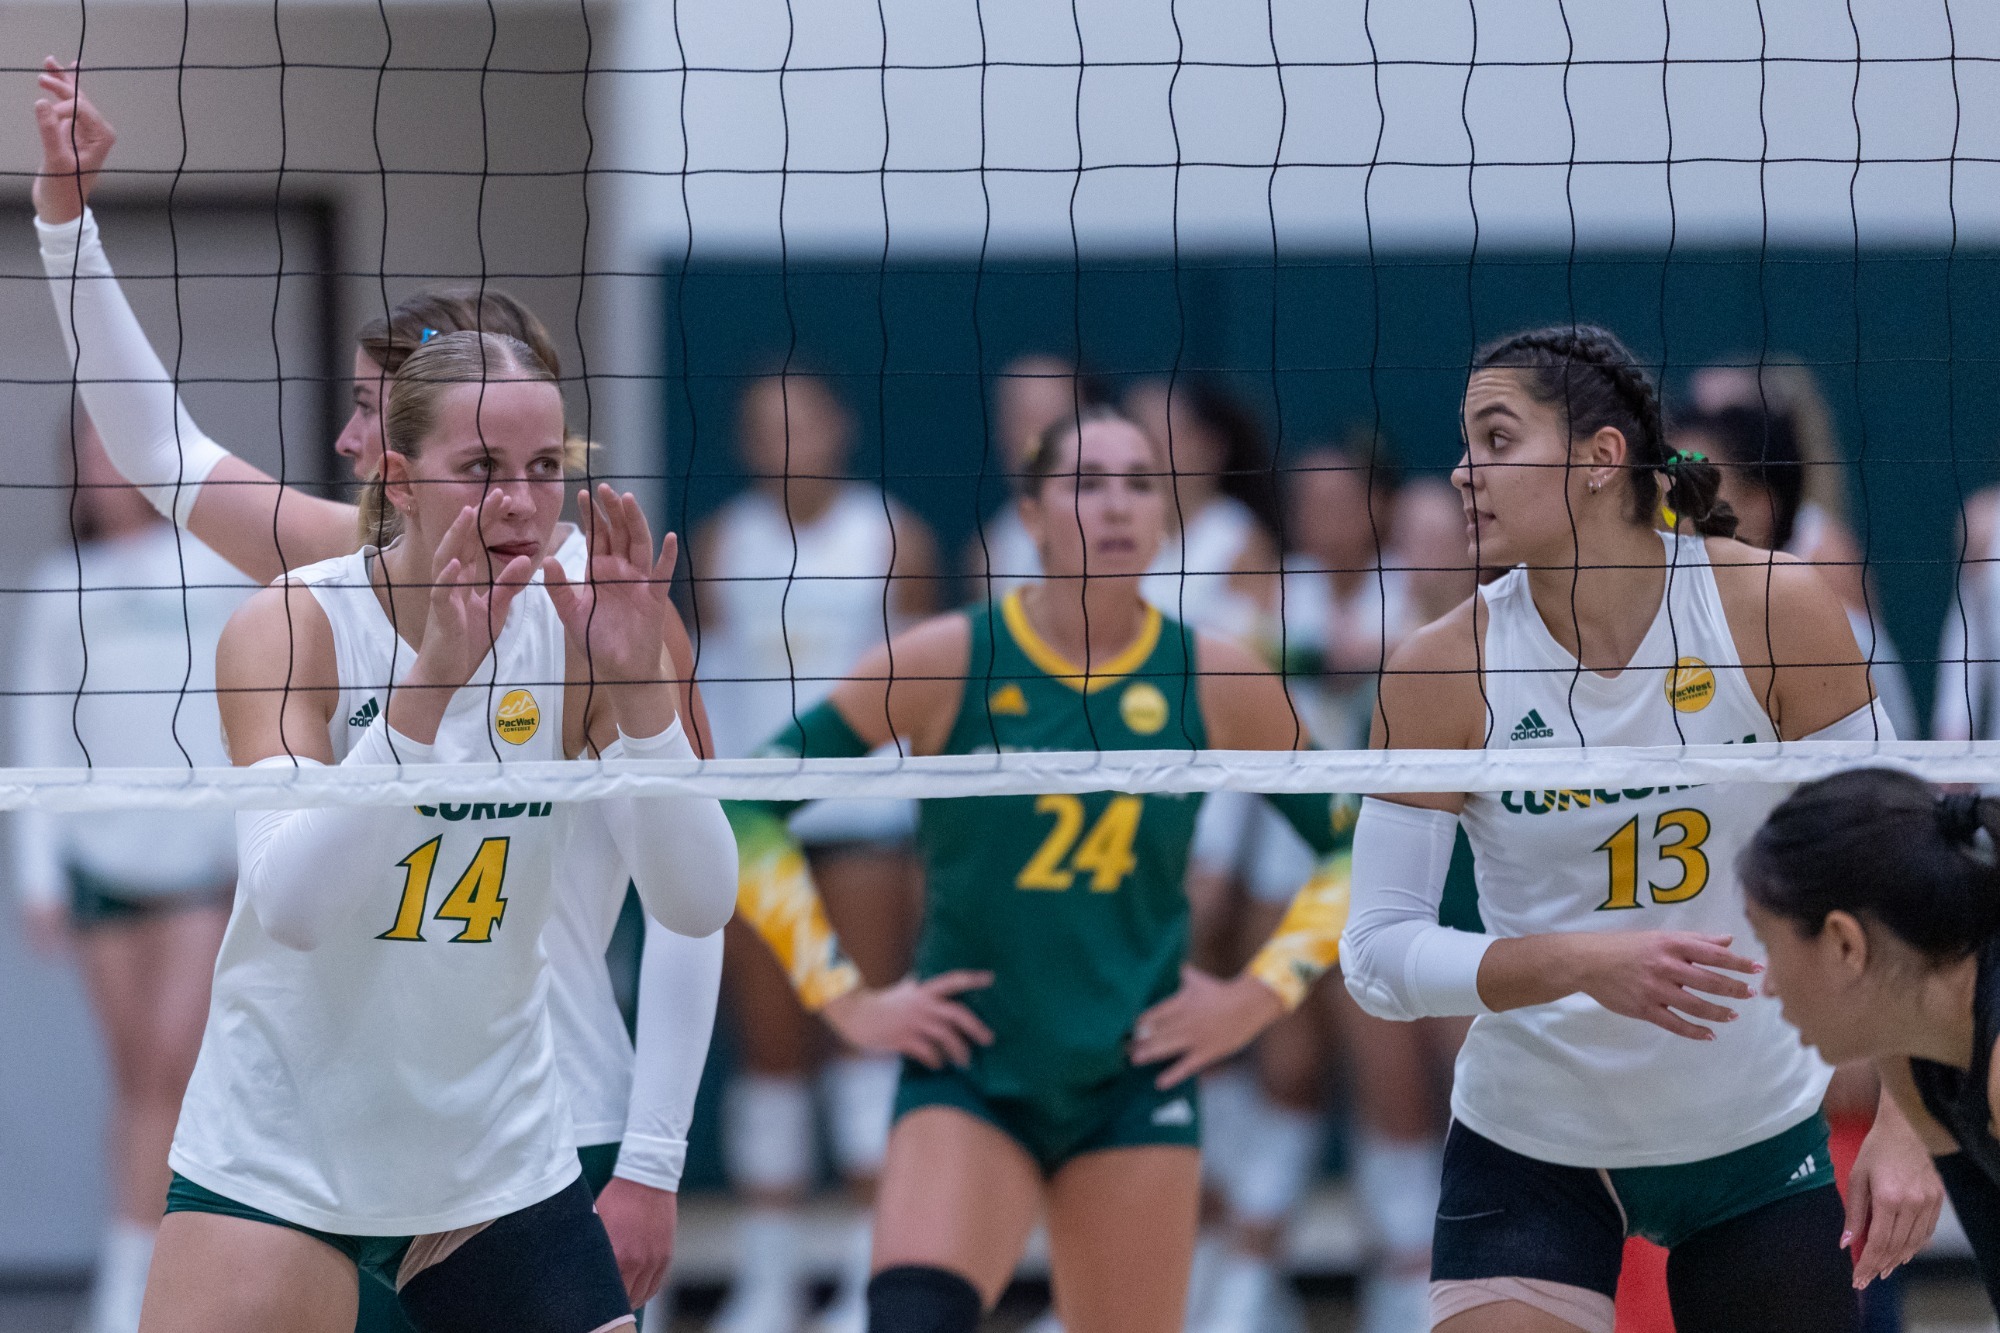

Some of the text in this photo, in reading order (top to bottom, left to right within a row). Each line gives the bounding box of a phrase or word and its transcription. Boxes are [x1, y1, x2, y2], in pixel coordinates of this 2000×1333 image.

[348, 716, 374, 727] adid
[1510, 727, 1554, 741] adidas
[374, 833, 511, 944] 14
[1015, 793, 1143, 892] 24
[1592, 807, 1711, 912] 13
